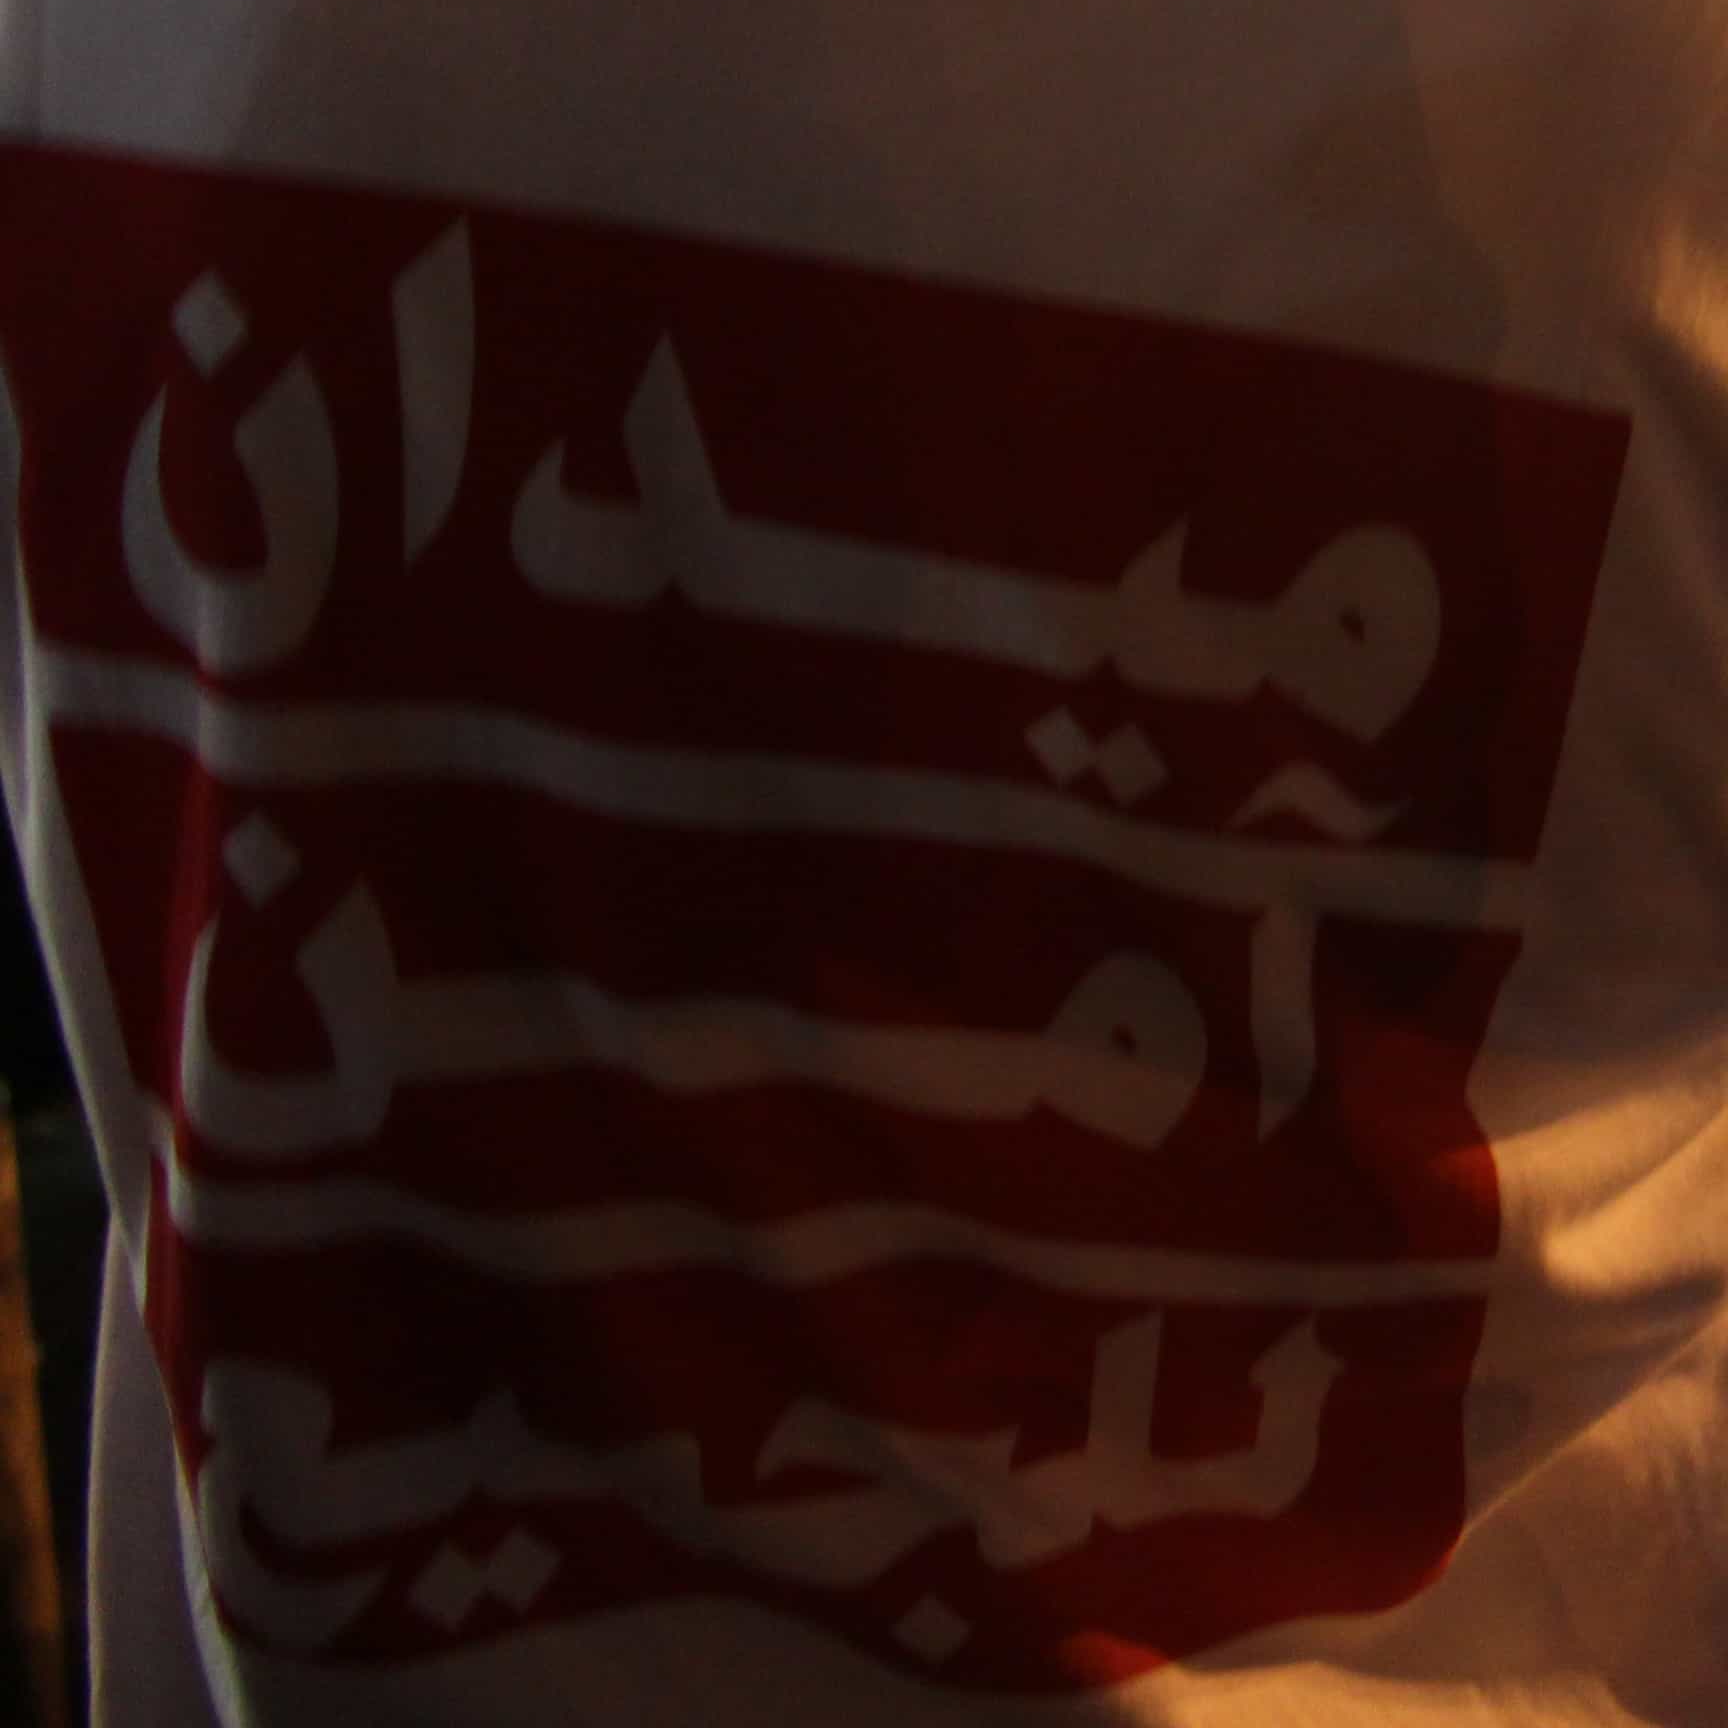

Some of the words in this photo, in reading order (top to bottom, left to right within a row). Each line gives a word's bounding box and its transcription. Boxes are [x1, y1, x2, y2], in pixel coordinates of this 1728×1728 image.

[120, 213, 1442, 807] ميدان
[180, 759, 1408, 1154] آمن
[197, 1308, 1346, 1668] للجميع
